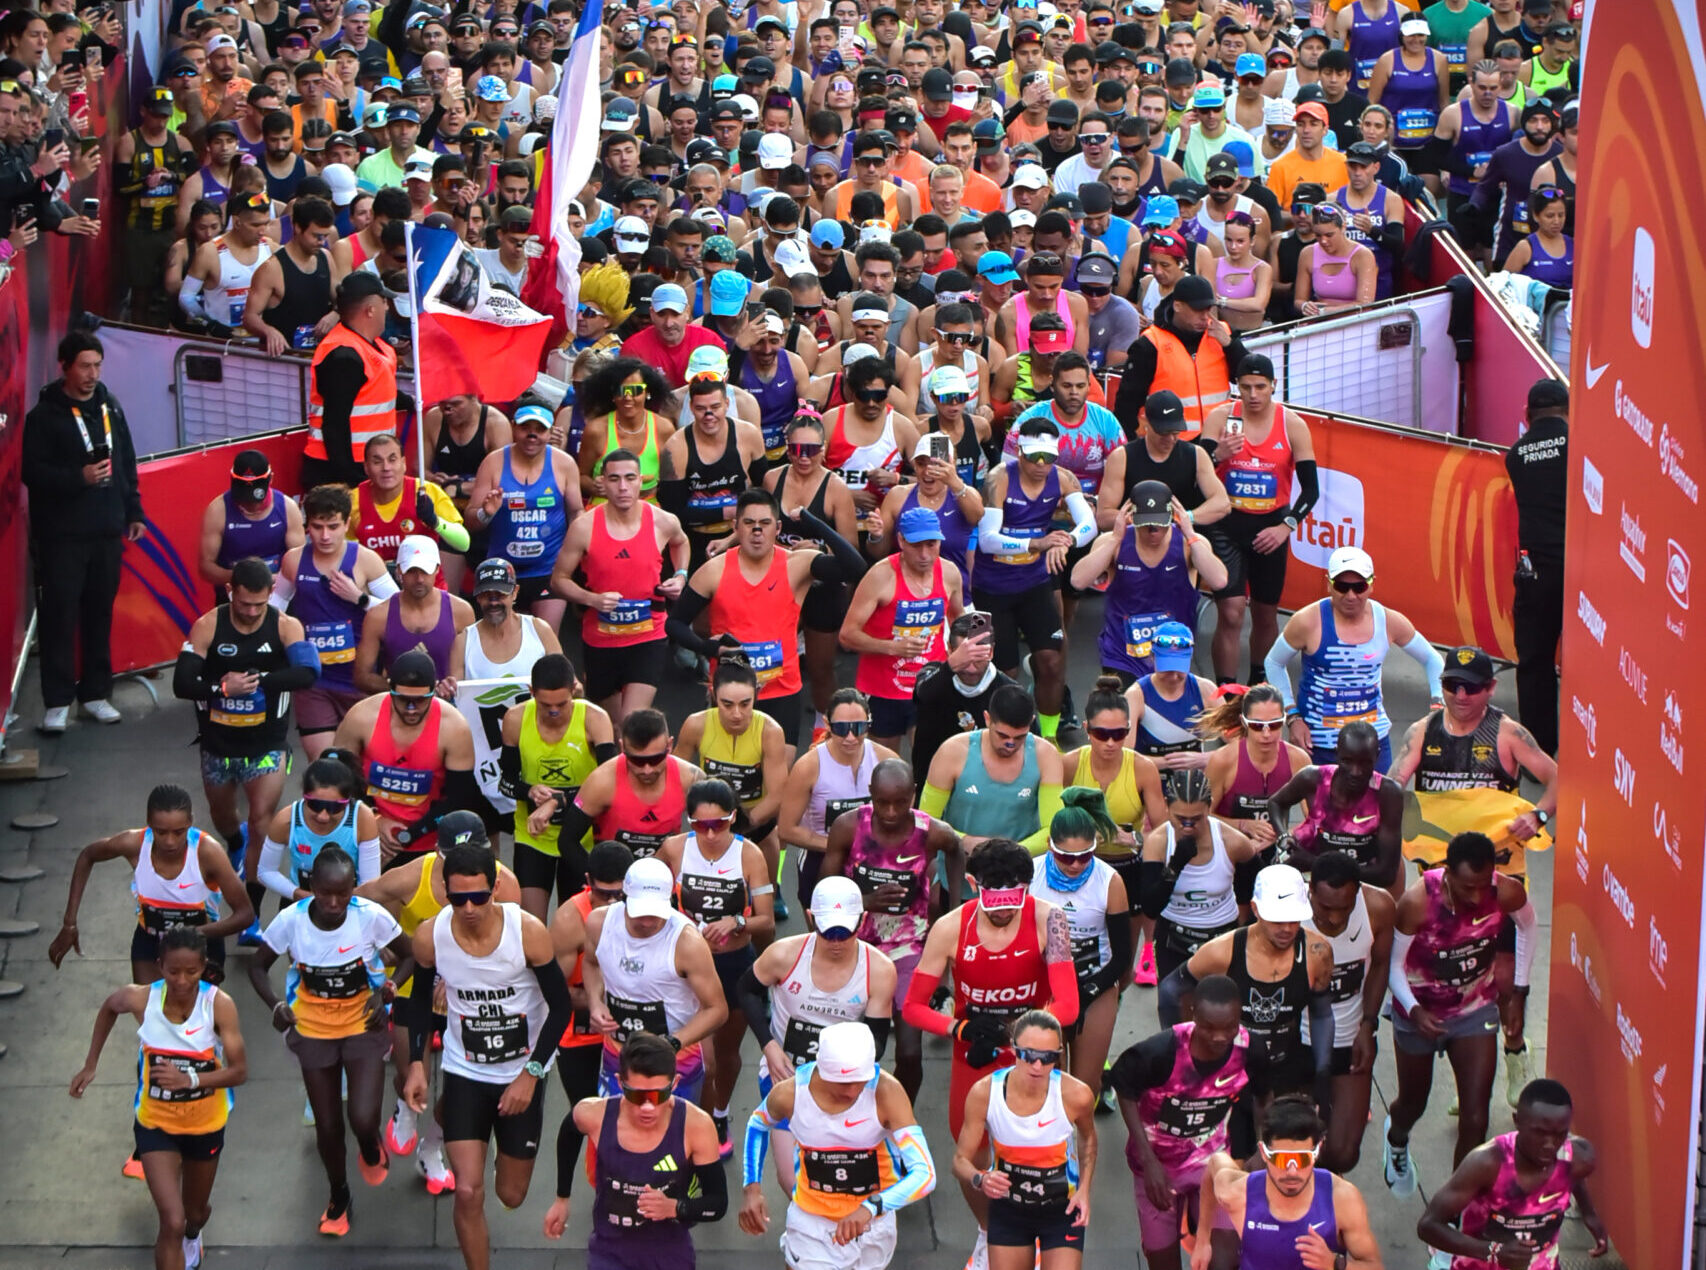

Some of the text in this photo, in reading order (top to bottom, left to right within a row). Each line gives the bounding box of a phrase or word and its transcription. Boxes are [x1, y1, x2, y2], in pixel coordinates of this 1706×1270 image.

[1404, 117, 1427, 128] 3321
[1634, 272, 1651, 327] itaú
[1518, 436, 1566, 455] SEGURIDAD
[1524, 448, 1560, 464] PRIVADA
[1234, 483, 1266, 495] 7831
[511, 510, 547, 523] OSCAR
[516, 526, 539, 540] 42K
[609, 610, 639, 622] 5131
[904, 612, 936, 625] 5167
[748, 655, 772, 668] 261
[219, 698, 254, 711] 1855
[1614, 747, 1636, 807] SKY
[380, 777, 418, 793] 5251
[702, 896, 724, 910] 22
[1456, 958, 1475, 972] 19
[325, 978, 345, 988] 13
[457, 986, 516, 1001] ARMADA
[960, 980, 1038, 1003] BEKOJI
[621, 1017, 644, 1031] 48
[484, 1034, 504, 1049] 16
[1186, 1112, 1205, 1125] 15
[835, 1168, 848, 1181] 8
[1020, 1182, 1044, 1196] 44
